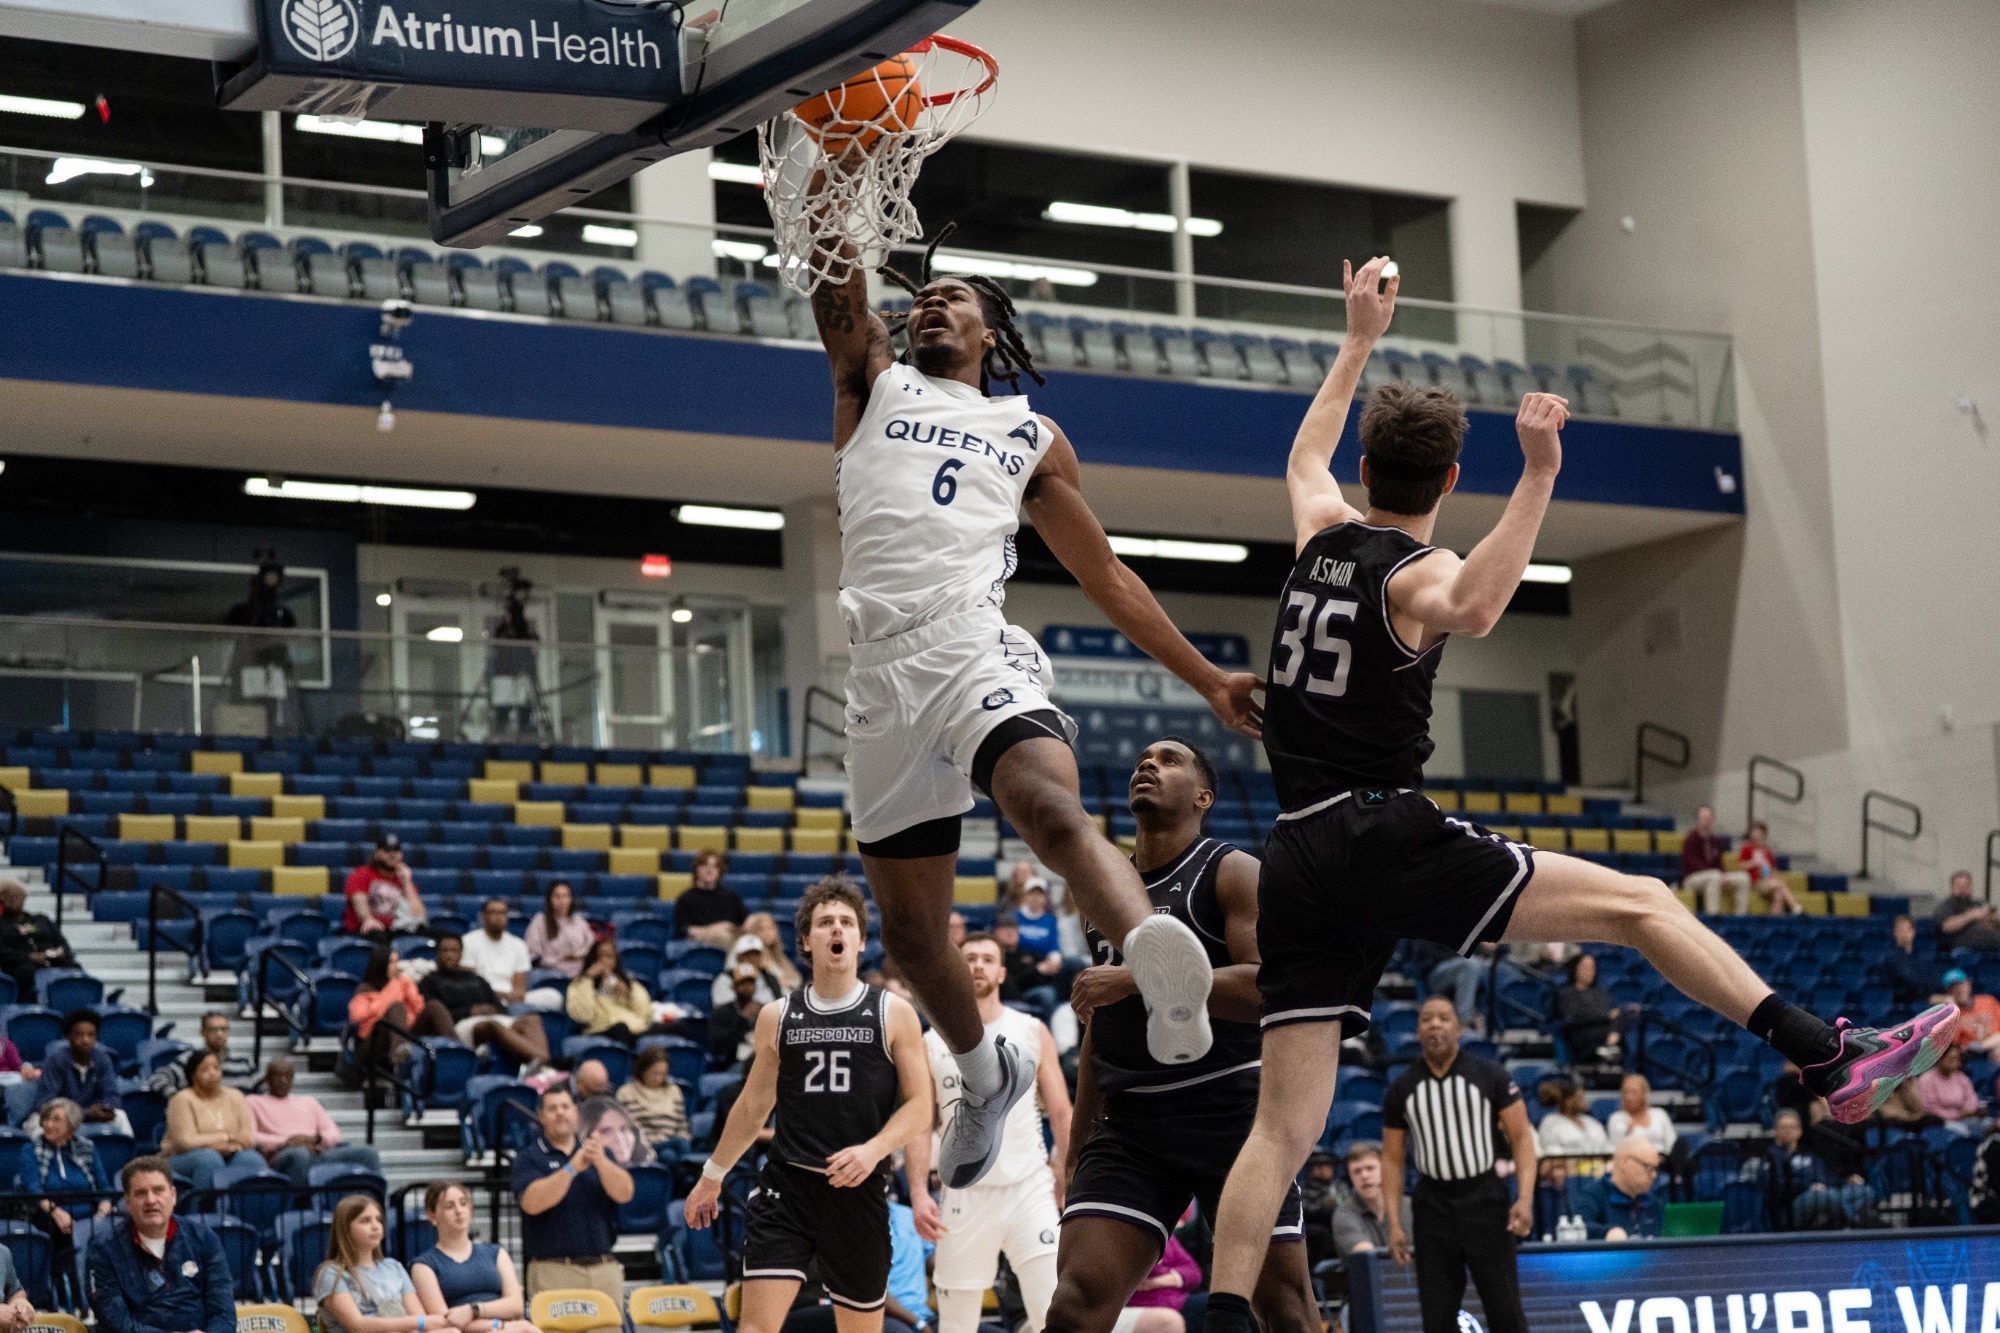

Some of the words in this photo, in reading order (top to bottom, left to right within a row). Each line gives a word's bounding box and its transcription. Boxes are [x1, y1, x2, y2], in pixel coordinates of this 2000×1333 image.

[372, 5, 524, 57] Atrium
[530, 19, 661, 69] Health
[885, 419, 1025, 476] QUEENS
[931, 458, 966, 506] 6
[1308, 555, 1356, 588] ASMAN
[1272, 590, 1359, 698] 35
[786, 1027, 874, 1044] LIPSCOMB
[804, 1050, 851, 1093] 26
[548, 1300, 599, 1319] QUEENS
[648, 1296, 698, 1315] QUEENS
